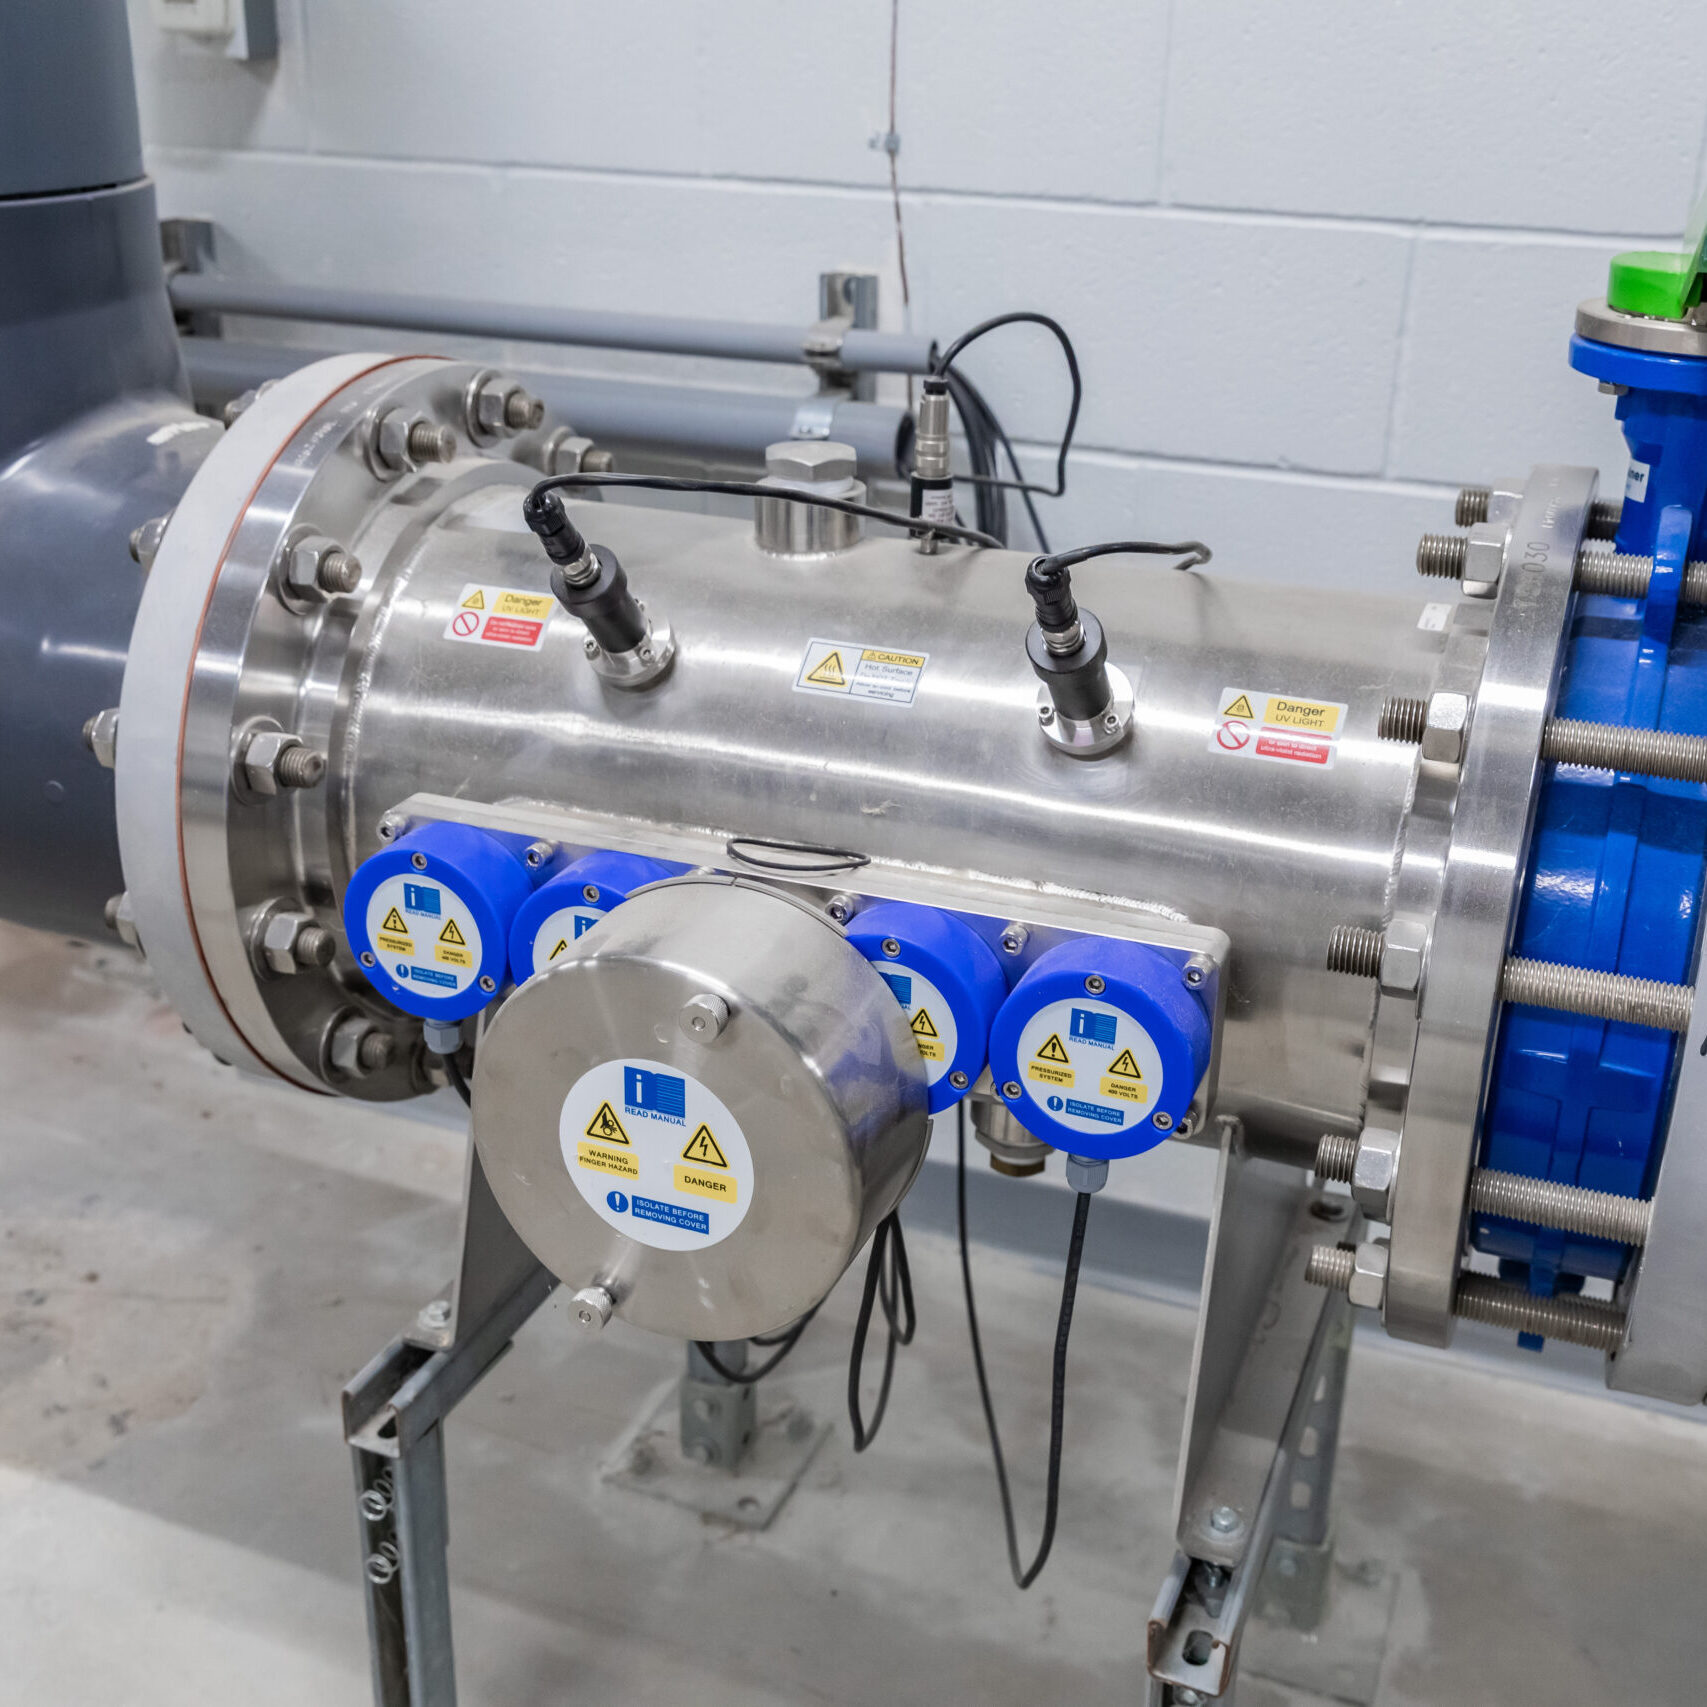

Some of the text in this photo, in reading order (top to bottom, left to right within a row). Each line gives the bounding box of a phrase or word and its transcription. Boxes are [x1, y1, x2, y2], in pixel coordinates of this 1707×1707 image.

[505, 594, 543, 606] Danger
[878, 653, 919, 665] CAUTION
[882, 666, 913, 676] Surface
[1277, 701, 1325, 717] Danger
[1275, 714, 1325, 727] UV LIGHT
[1069, 1036, 1114, 1051] READ MANUAL
[1031, 1065, 1072, 1079] PRESSURIZED
[1039, 1073, 1063, 1083] SYSTEM
[1111, 1082, 1136, 1092] DANGER
[1119, 1091, 1138, 1099] VOLTS
[1067, 1107, 1122, 1123] REMOVING COVER
[1069, 1101, 1120, 1116] ISOLATE BEFORE
[624, 1106, 686, 1127] READ MANUAL
[589, 1149, 629, 1165] WARNING
[579, 1156, 638, 1175] FINGER HAZARD
[684, 1175, 727, 1193] DANGER
[636, 1200, 704, 1221] ISOLATE BEFORE
[634, 1207, 707, 1231] REMOVING COVER
